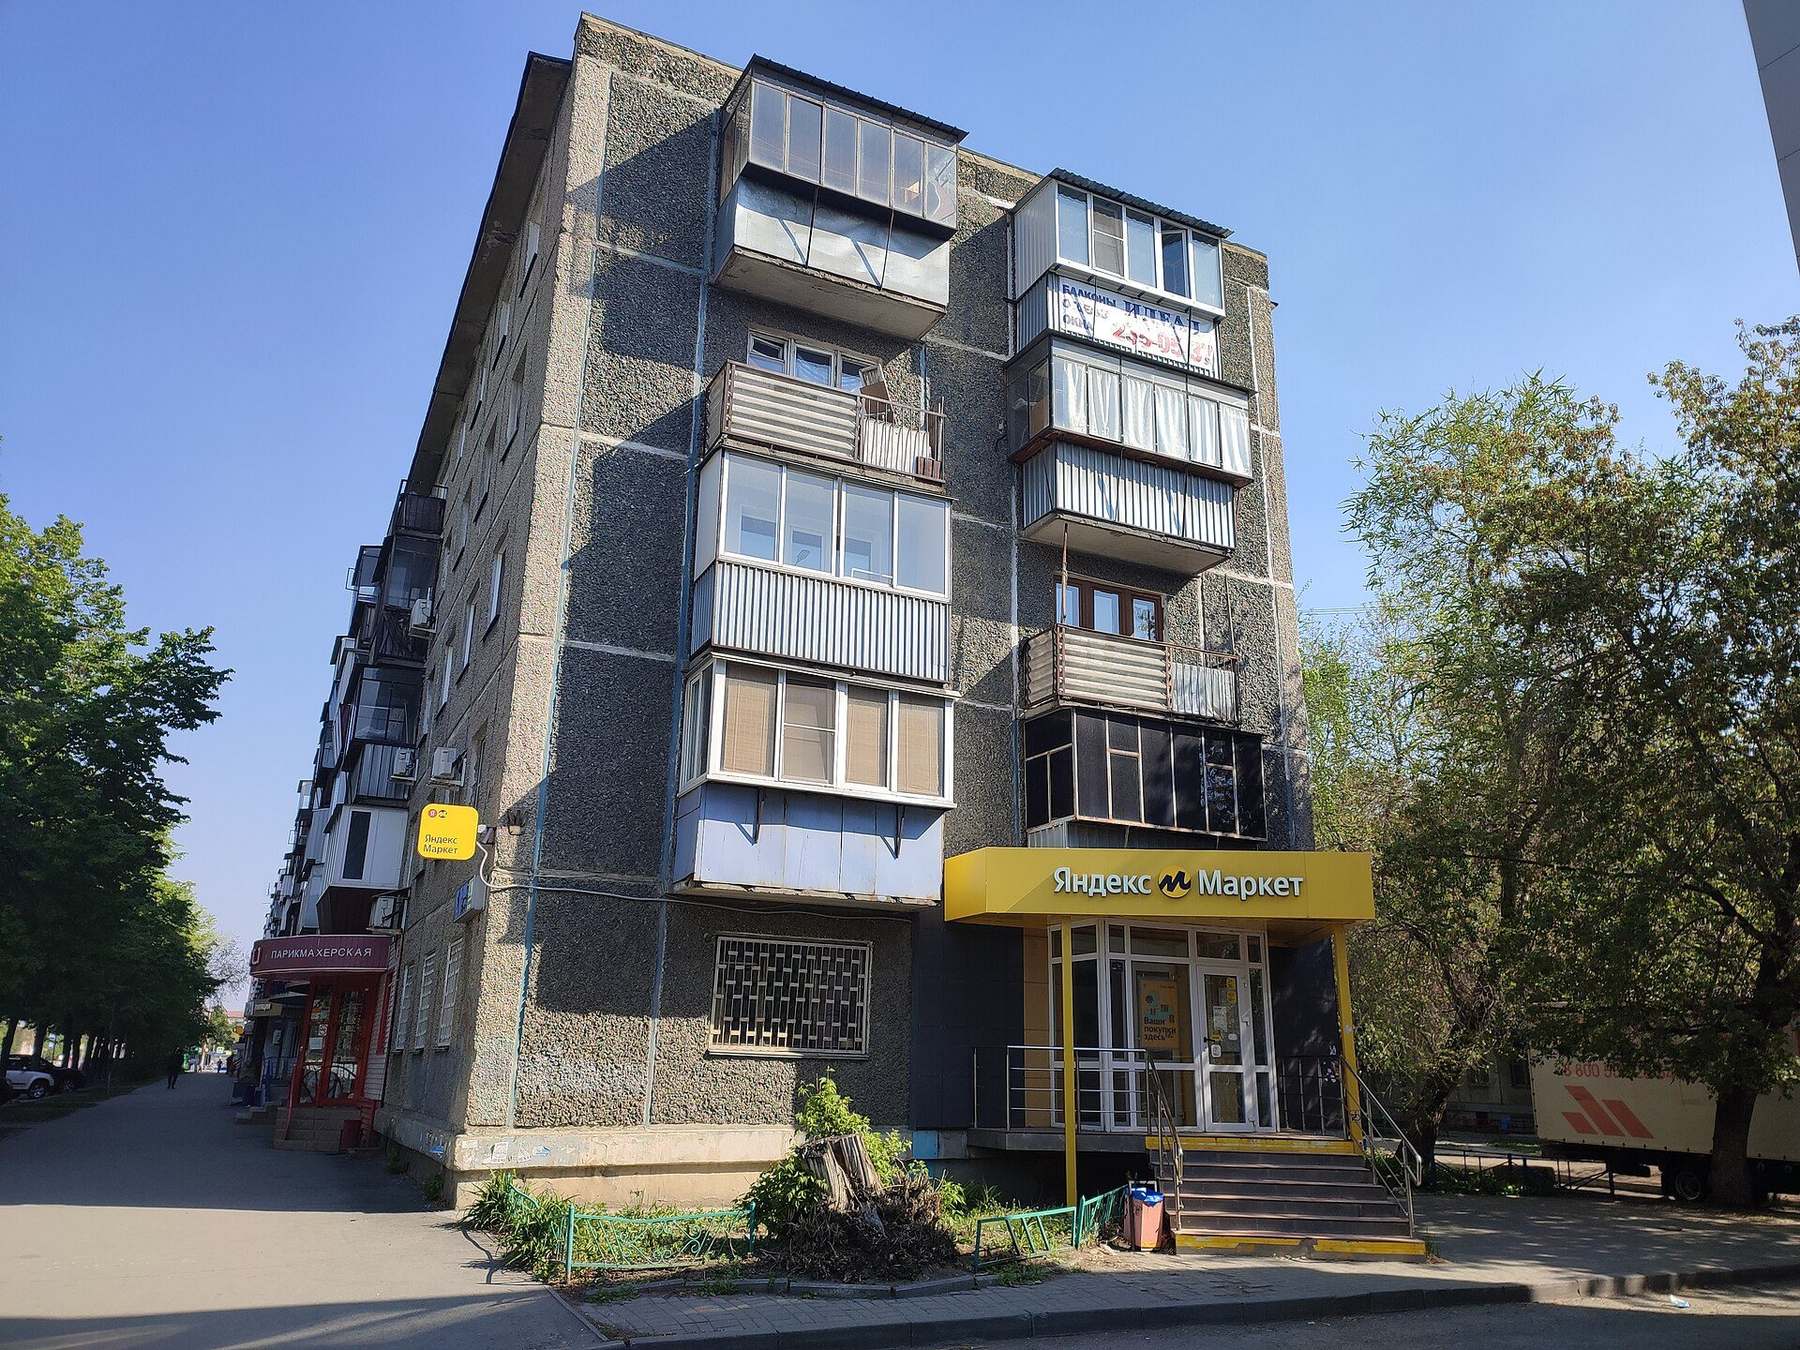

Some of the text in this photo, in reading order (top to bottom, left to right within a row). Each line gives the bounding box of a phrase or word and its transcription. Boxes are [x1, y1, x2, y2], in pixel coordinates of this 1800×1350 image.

[1062, 284, 1117, 307] БАЛКОНЫ
[425, 834, 457, 844] Яндекс
[423, 844, 458, 854] Маркет
[1054, 867, 1152, 897] Яндекс
[1199, 869, 1303, 900] Маркет
[271, 947, 372, 959] ПАРИКМАХЕРСКАЯ
[1575, 1062, 1600, 1077] 800
